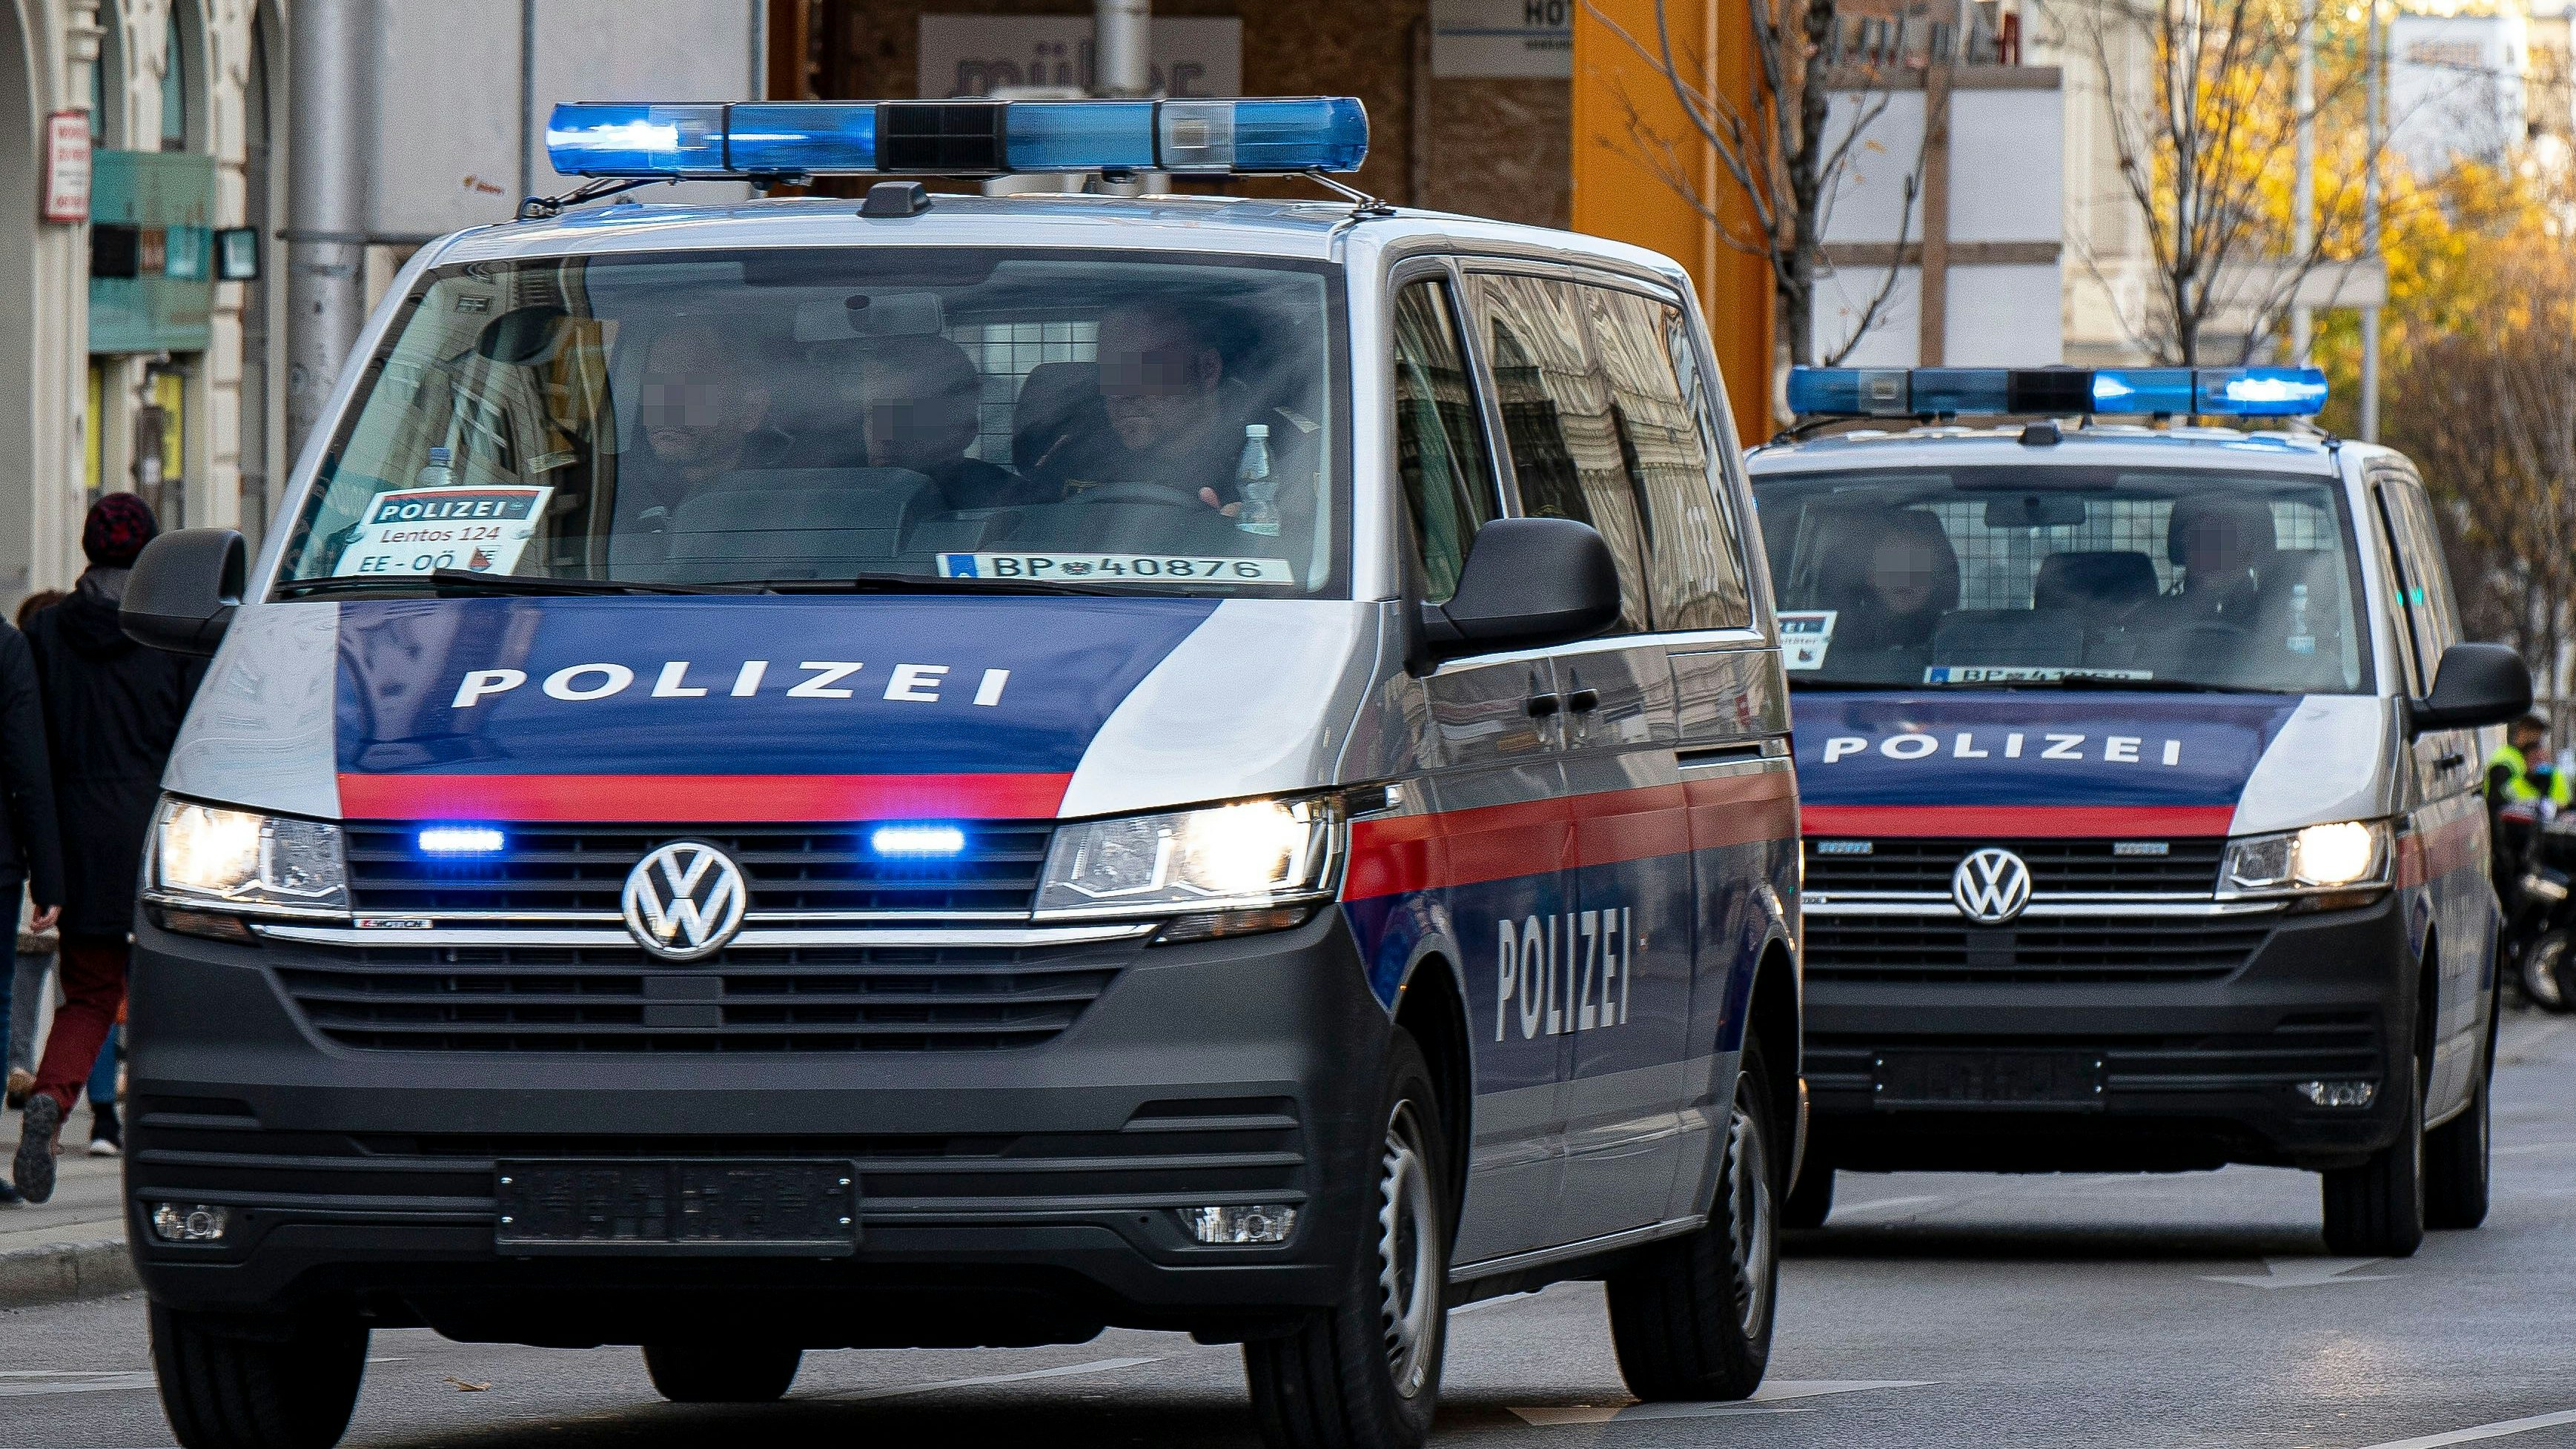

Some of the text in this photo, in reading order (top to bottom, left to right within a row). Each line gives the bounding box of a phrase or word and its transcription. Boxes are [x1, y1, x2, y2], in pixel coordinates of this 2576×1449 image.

[379, 501, 506, 520] POLIZEI
[380, 526, 501, 543] Lentos 124
[358, 555, 391, 571] EE
[412, 549, 455, 570] OÖ
[990, 557, 1261, 578] BP 40876
[451, 660, 1010, 708] POLIZEI
[1964, 669, 2004, 681] BP
[1823, 733, 2180, 766] POLIZEI
[1954, 849, 2029, 922] VW
[626, 845, 742, 955] VW
[1495, 907, 1631, 1042] POLIZEI
